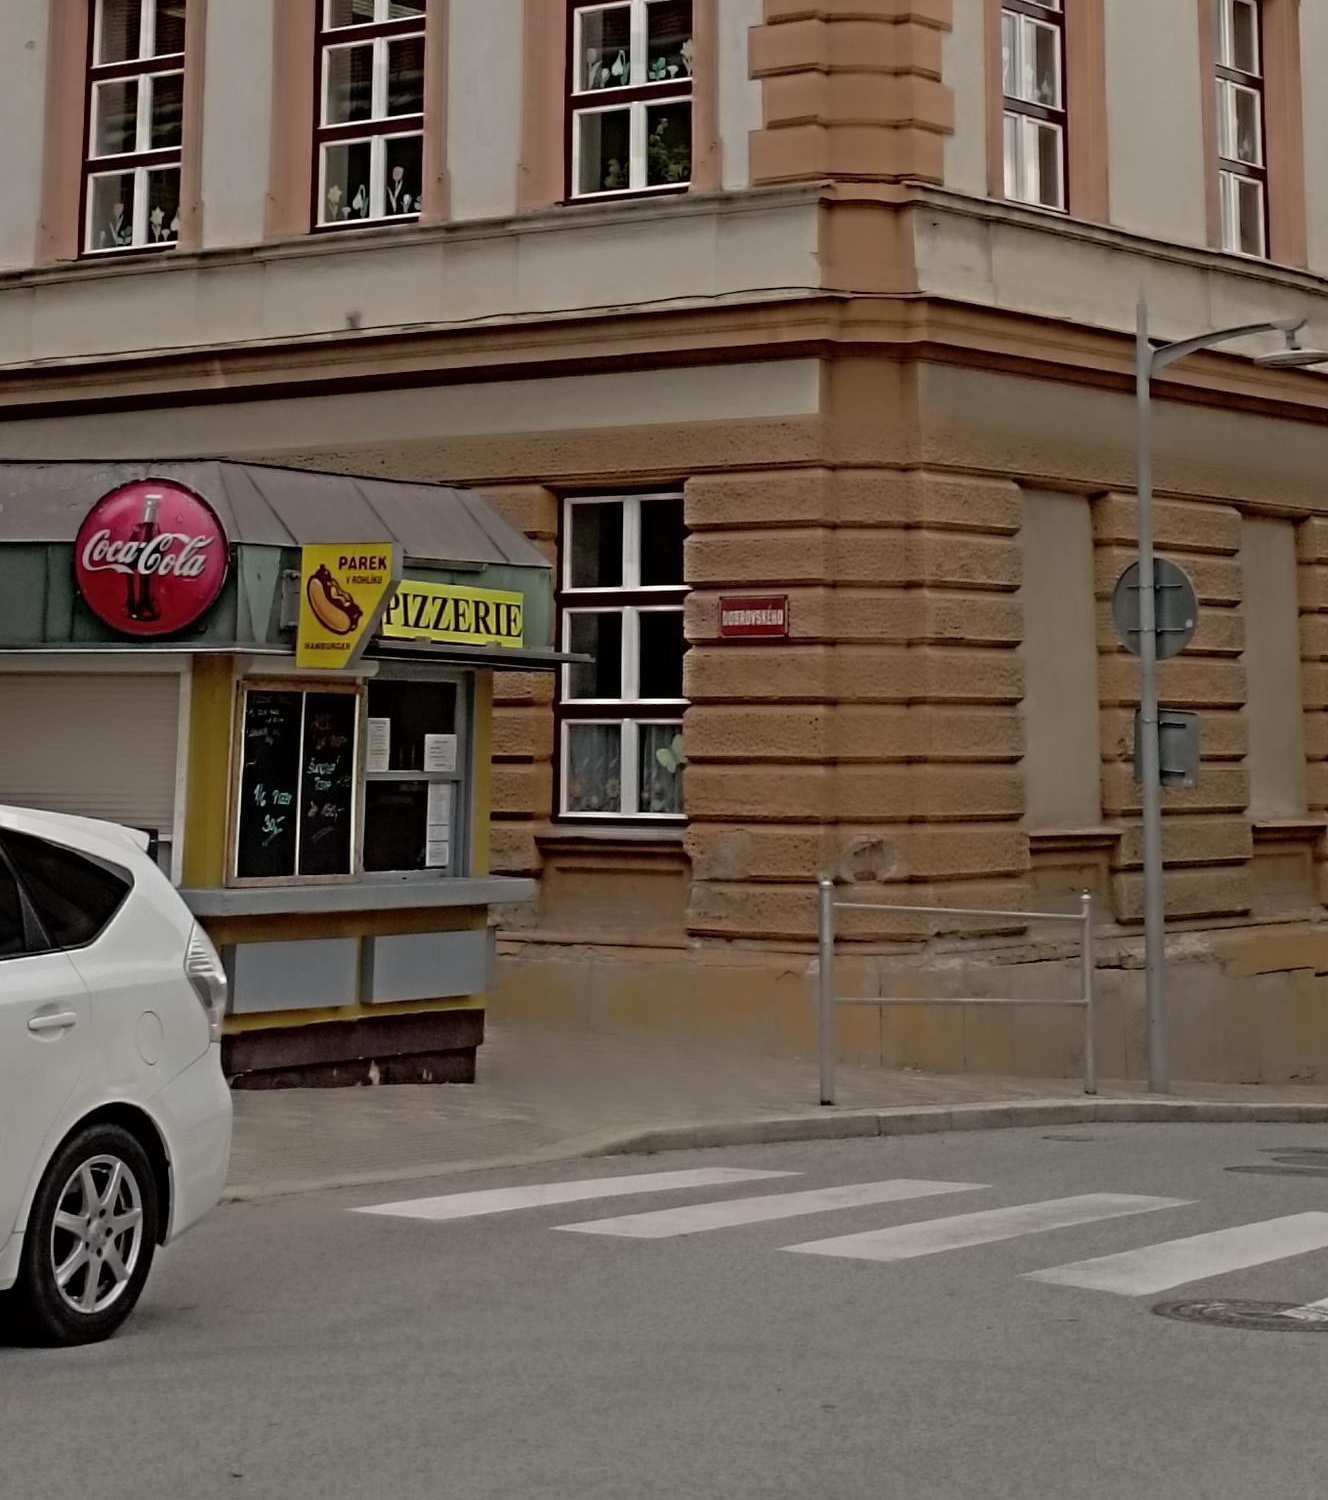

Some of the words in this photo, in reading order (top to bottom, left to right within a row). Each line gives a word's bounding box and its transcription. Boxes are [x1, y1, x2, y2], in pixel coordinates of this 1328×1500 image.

[82, 529, 214, 576] Coca-Cola
[384, 592, 521, 637] PIZZERIE
[303, 642, 351, 651] HAMBURGER
